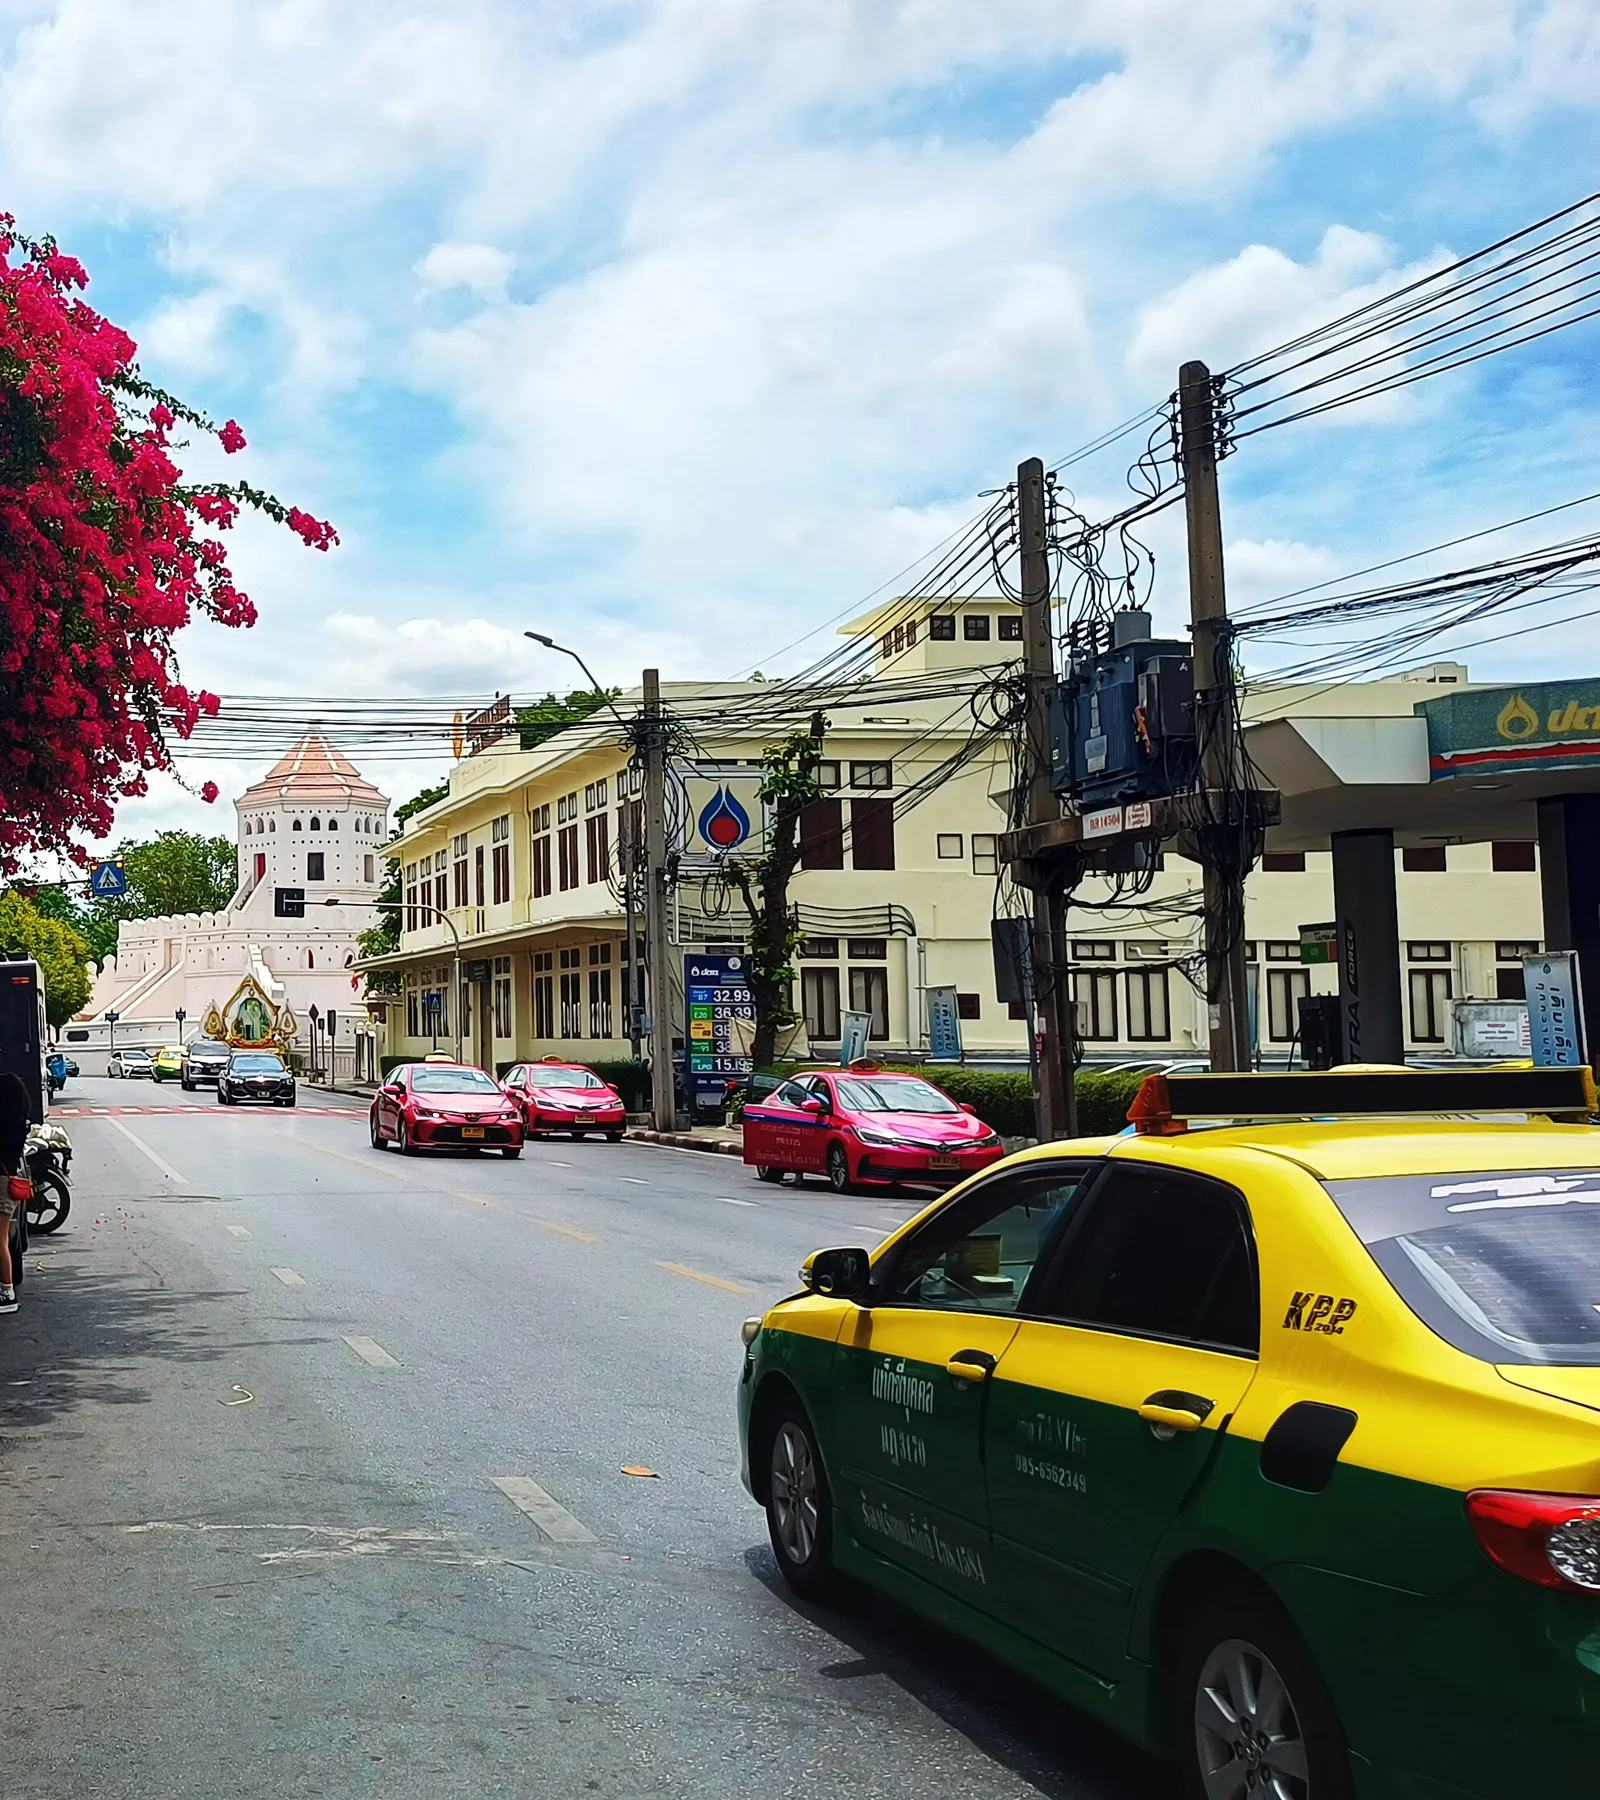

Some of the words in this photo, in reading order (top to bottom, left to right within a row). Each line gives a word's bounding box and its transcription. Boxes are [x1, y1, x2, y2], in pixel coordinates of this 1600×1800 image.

[1347, 929, 1357, 986] FORCE
[713, 990, 751, 1002] 32.99
[714, 1007, 752, 1019] 3639
[1282, 1290, 1359, 1332] KPP
[1313, 1322, 1345, 1336] 2014
